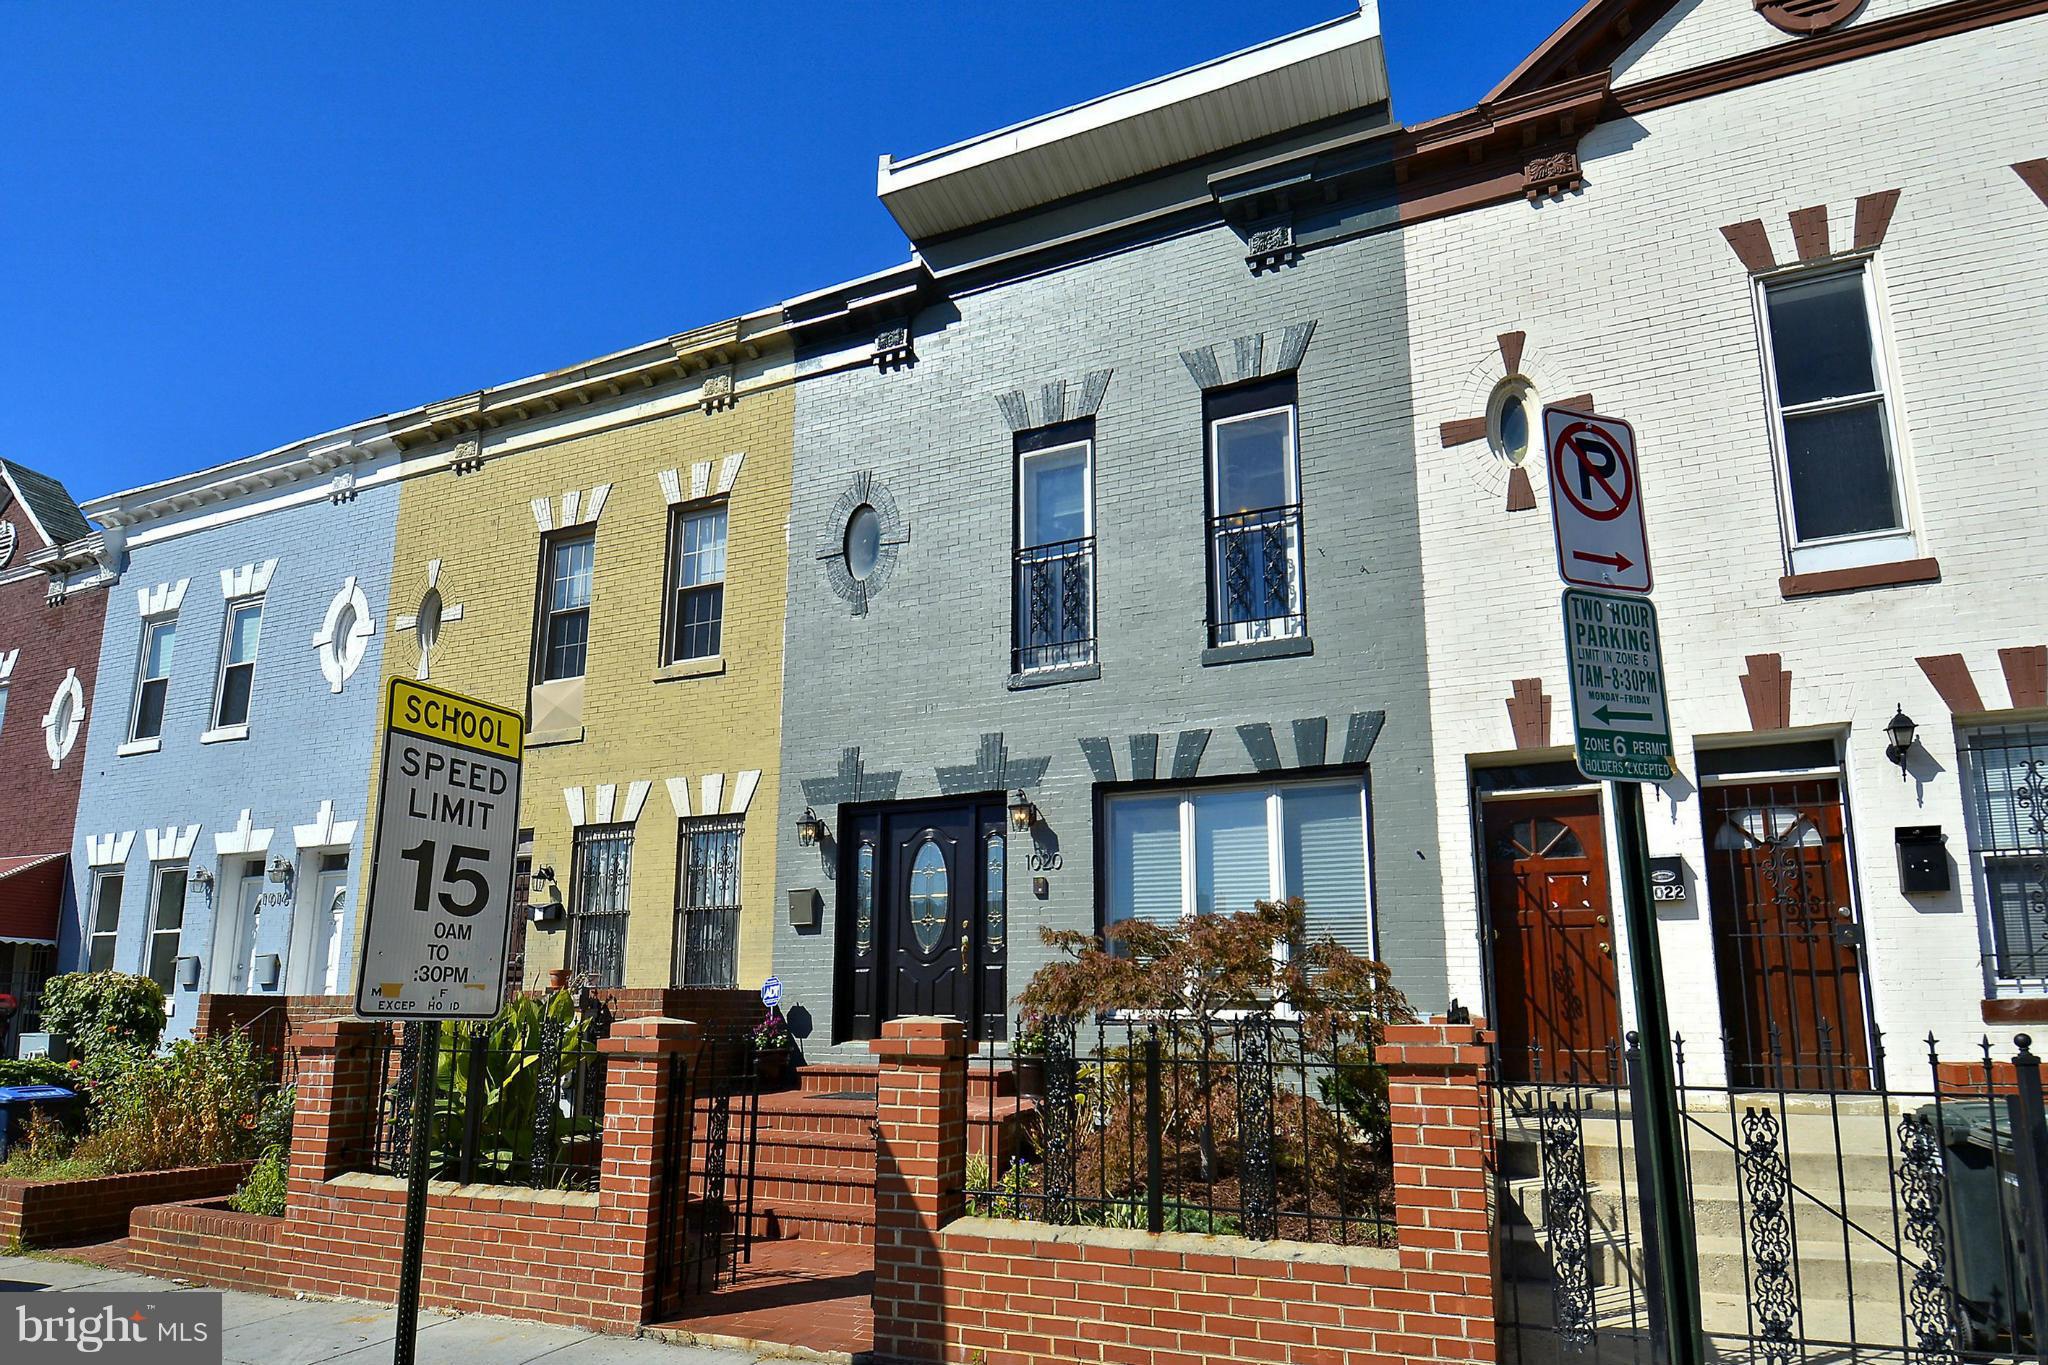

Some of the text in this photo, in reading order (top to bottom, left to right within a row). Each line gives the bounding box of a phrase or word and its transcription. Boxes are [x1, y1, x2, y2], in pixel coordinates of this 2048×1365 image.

[1571, 597, 1649, 628] TWO HOUR
[1576, 622, 1650, 652] PARKING
[1577, 647, 1649, 667] LIMIT IN ZONE 6
[1578, 663, 1658, 694] 7AM-8:30PM
[1588, 690, 1651, 705] MONDAY-FRIDAY
[405, 694, 511, 749] SCHOOL
[1584, 735, 1668, 757] ZONE 6 PERMIT
[400, 746, 508, 796] SPEED
[1585, 760, 1624, 775] HOLDERS
[408, 788, 495, 831] LIMIT
[1025, 853, 1063, 872] 1020
[401, 839, 490, 918] 15
[427, 944, 449, 961] TO
[764, 984, 780, 999] ADT
